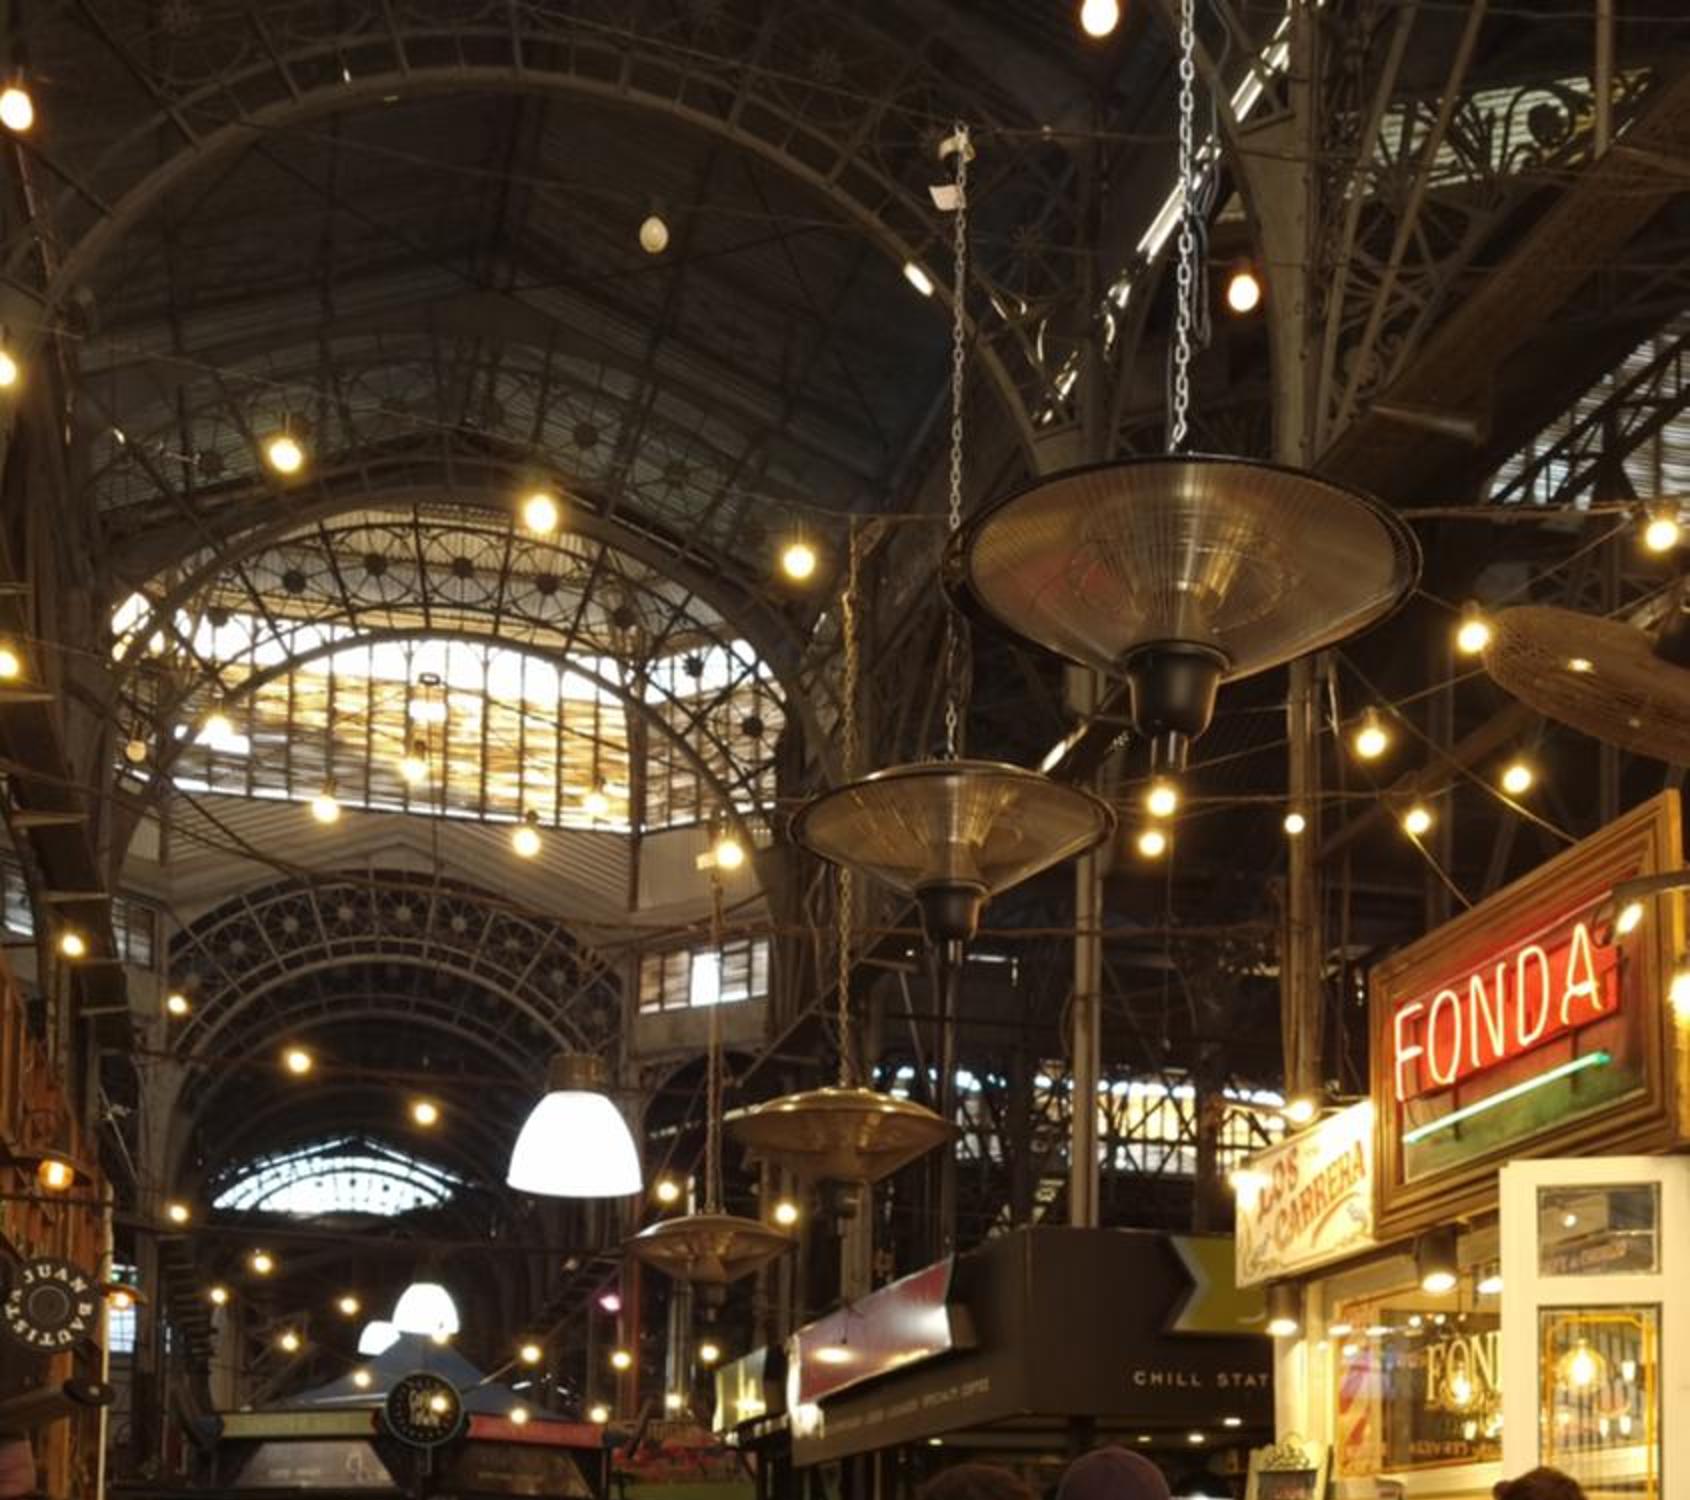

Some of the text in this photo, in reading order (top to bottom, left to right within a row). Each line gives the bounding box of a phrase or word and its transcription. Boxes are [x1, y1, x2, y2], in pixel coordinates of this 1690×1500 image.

[1394, 923, 1604, 1101] FONDA
[23, 1264, 88, 1293] JUAN
[1133, 1370, 1200, 1387] CHILL
